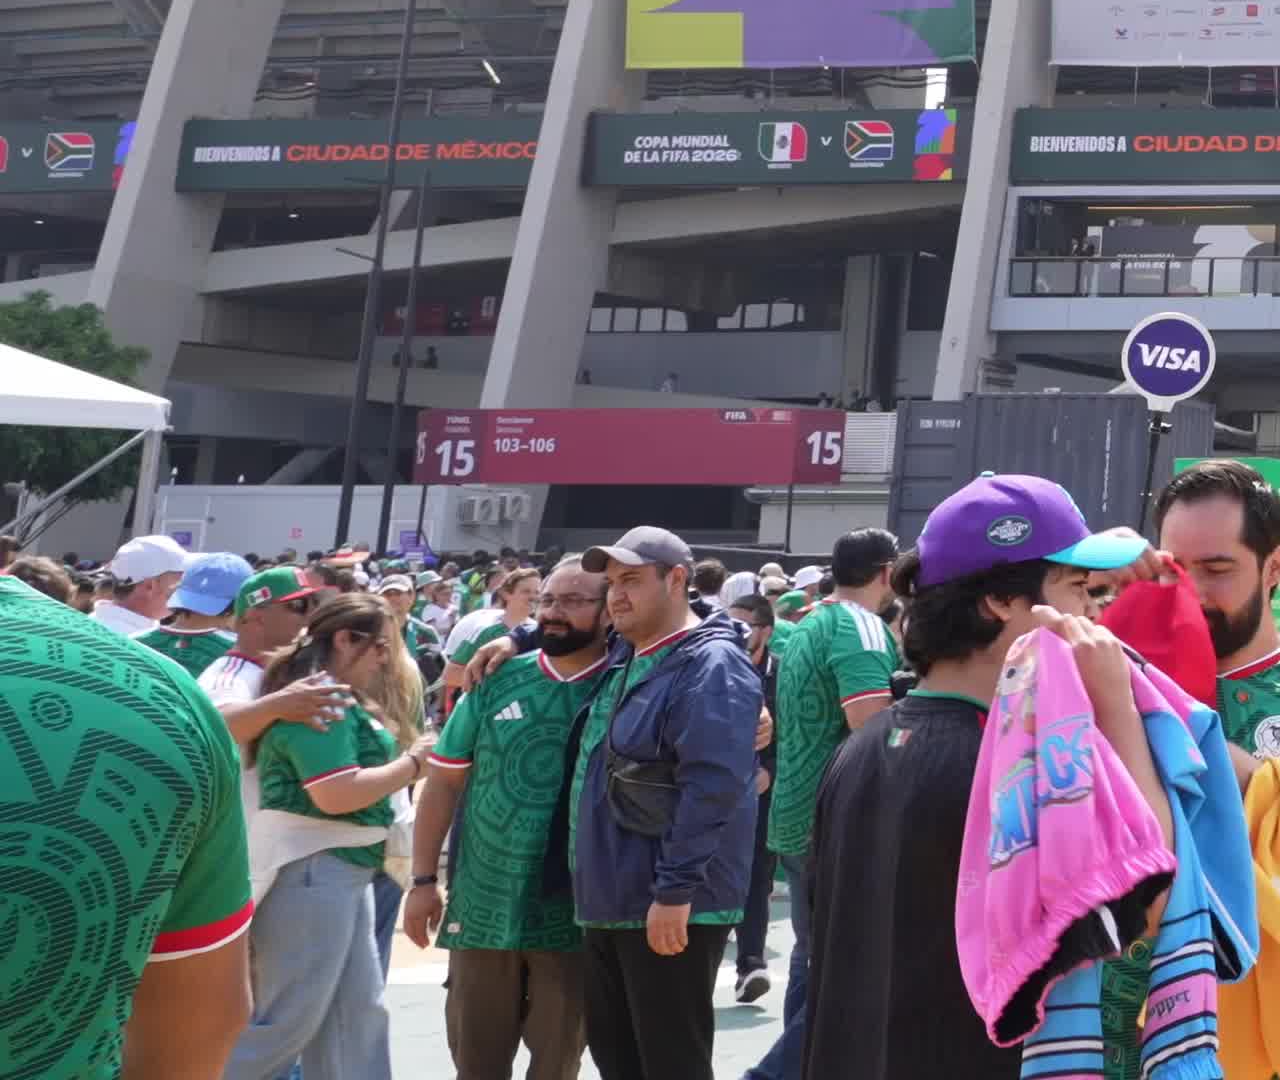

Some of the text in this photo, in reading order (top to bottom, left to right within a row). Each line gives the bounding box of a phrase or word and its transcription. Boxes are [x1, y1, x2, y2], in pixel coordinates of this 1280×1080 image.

[634, 135, 730, 149] COPA MUNDIAL
[1030, 135, 1117, 153] BIENVENIDOS
[1117, 135, 1127, 153] A
[1132, 135, 1249, 153] CIUDAD
[286, 144, 389, 161] CIUDAD
[395, 143, 430, 160] DE
[624, 149, 738, 164] DE LA FIFA 2026
[1135, 342, 1201, 374] VISA
[724, 411, 747, 421] FIFA
[807, 430, 842, 465] 15
[435, 439, 475, 476] 15
